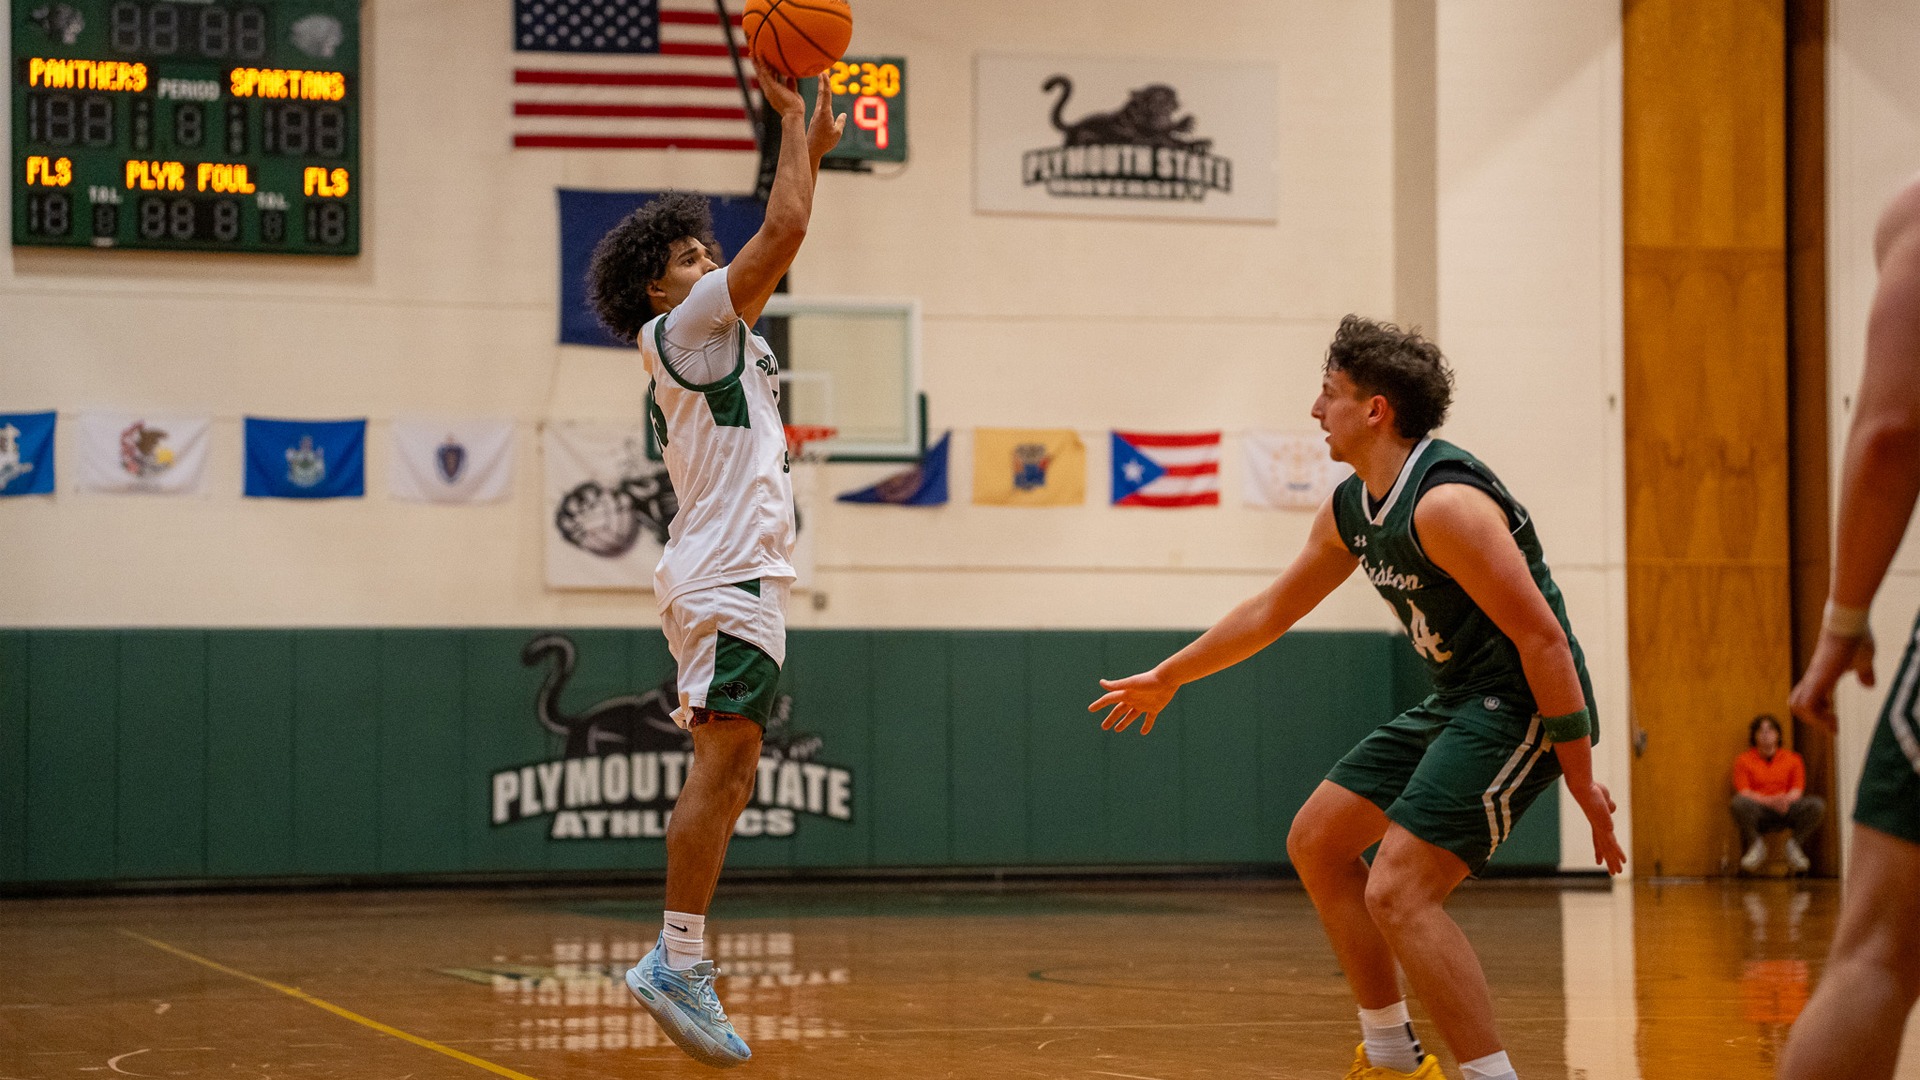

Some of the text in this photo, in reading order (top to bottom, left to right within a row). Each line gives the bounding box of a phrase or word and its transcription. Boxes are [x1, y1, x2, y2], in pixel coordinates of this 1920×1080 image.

[29, 57, 149, 92] PANTHERS
[157, 78, 221, 101] PERIOD
[230, 67, 346, 101] SPARTANS
[853, 95, 889, 149] 9
[26, 156, 73, 187] FLS
[125, 160, 256, 194] PLYR FOUL
[303, 166, 349, 198] FLS
[492, 752, 852, 824] PLYMOUT TATE
[550, 808, 796, 840] ATHLCS
